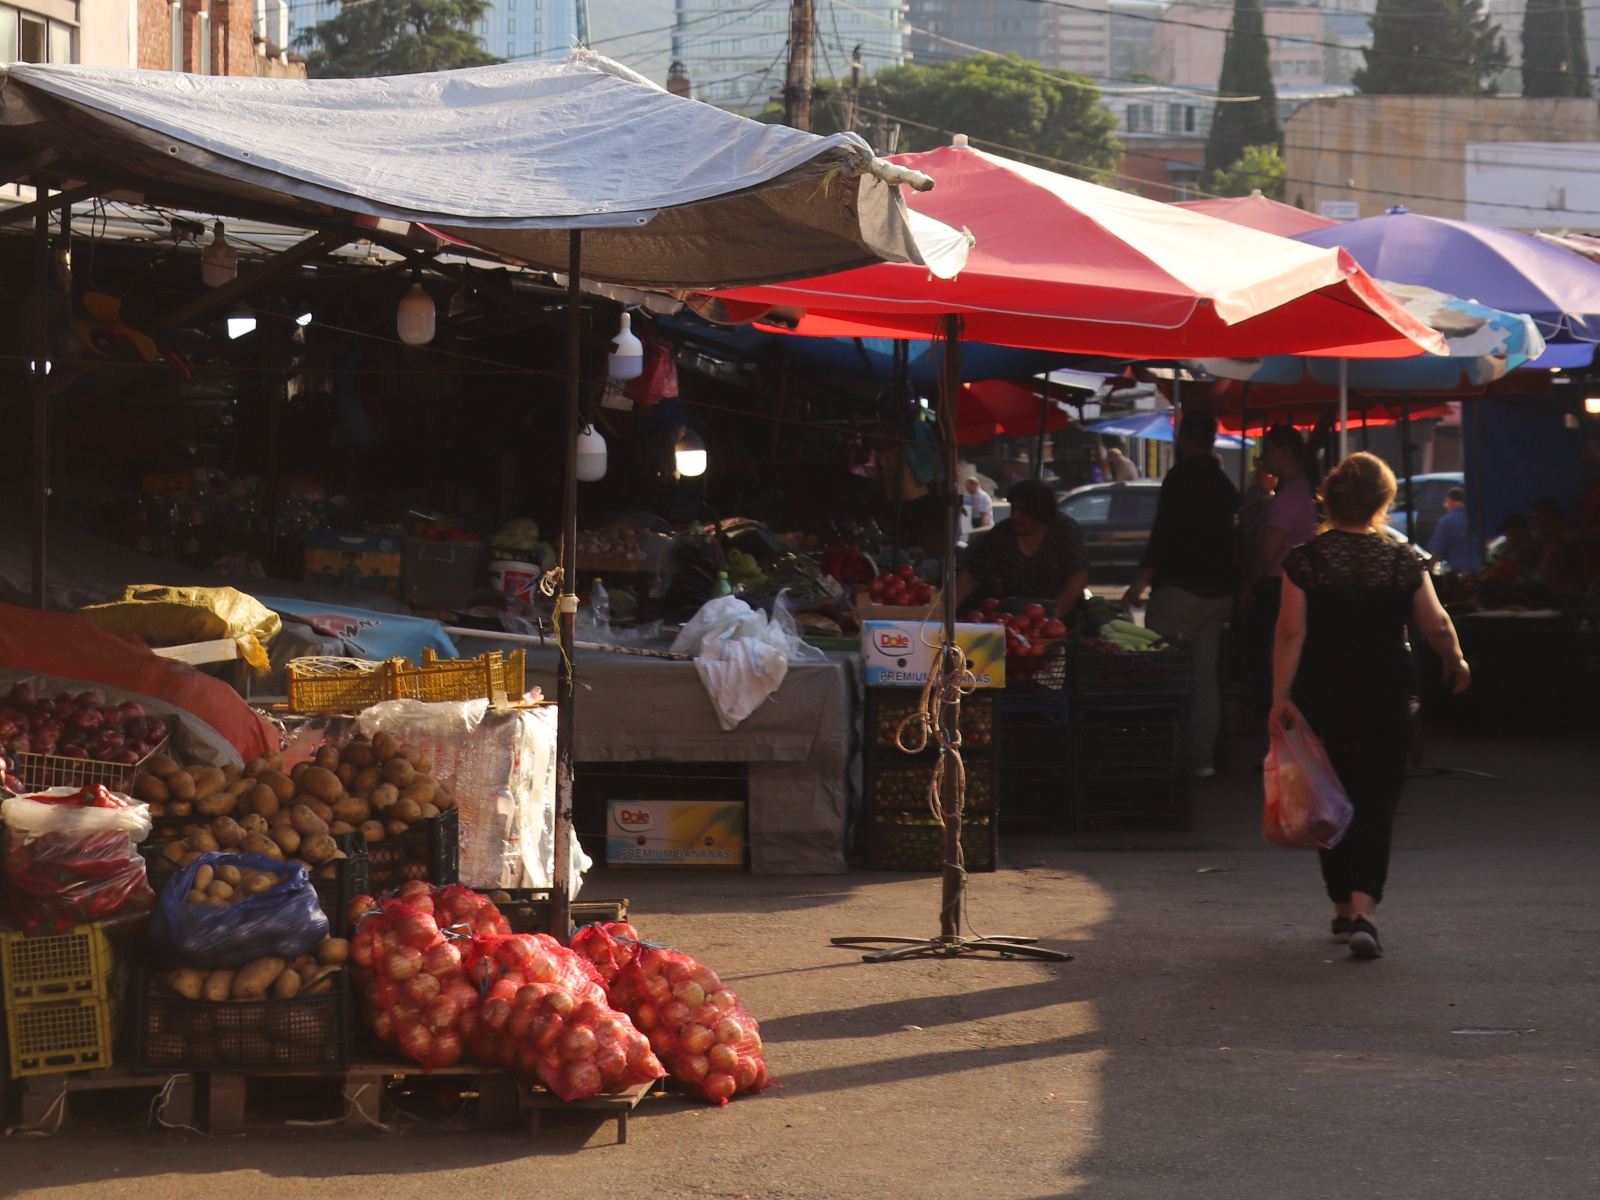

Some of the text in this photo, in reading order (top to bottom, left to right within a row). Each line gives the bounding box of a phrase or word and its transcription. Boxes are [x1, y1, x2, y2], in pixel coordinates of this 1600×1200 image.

[881, 634, 909, 647] Dole
[621, 810, 650, 823] Dole
[620, 848, 732, 859] PREMIUM BANANAS
